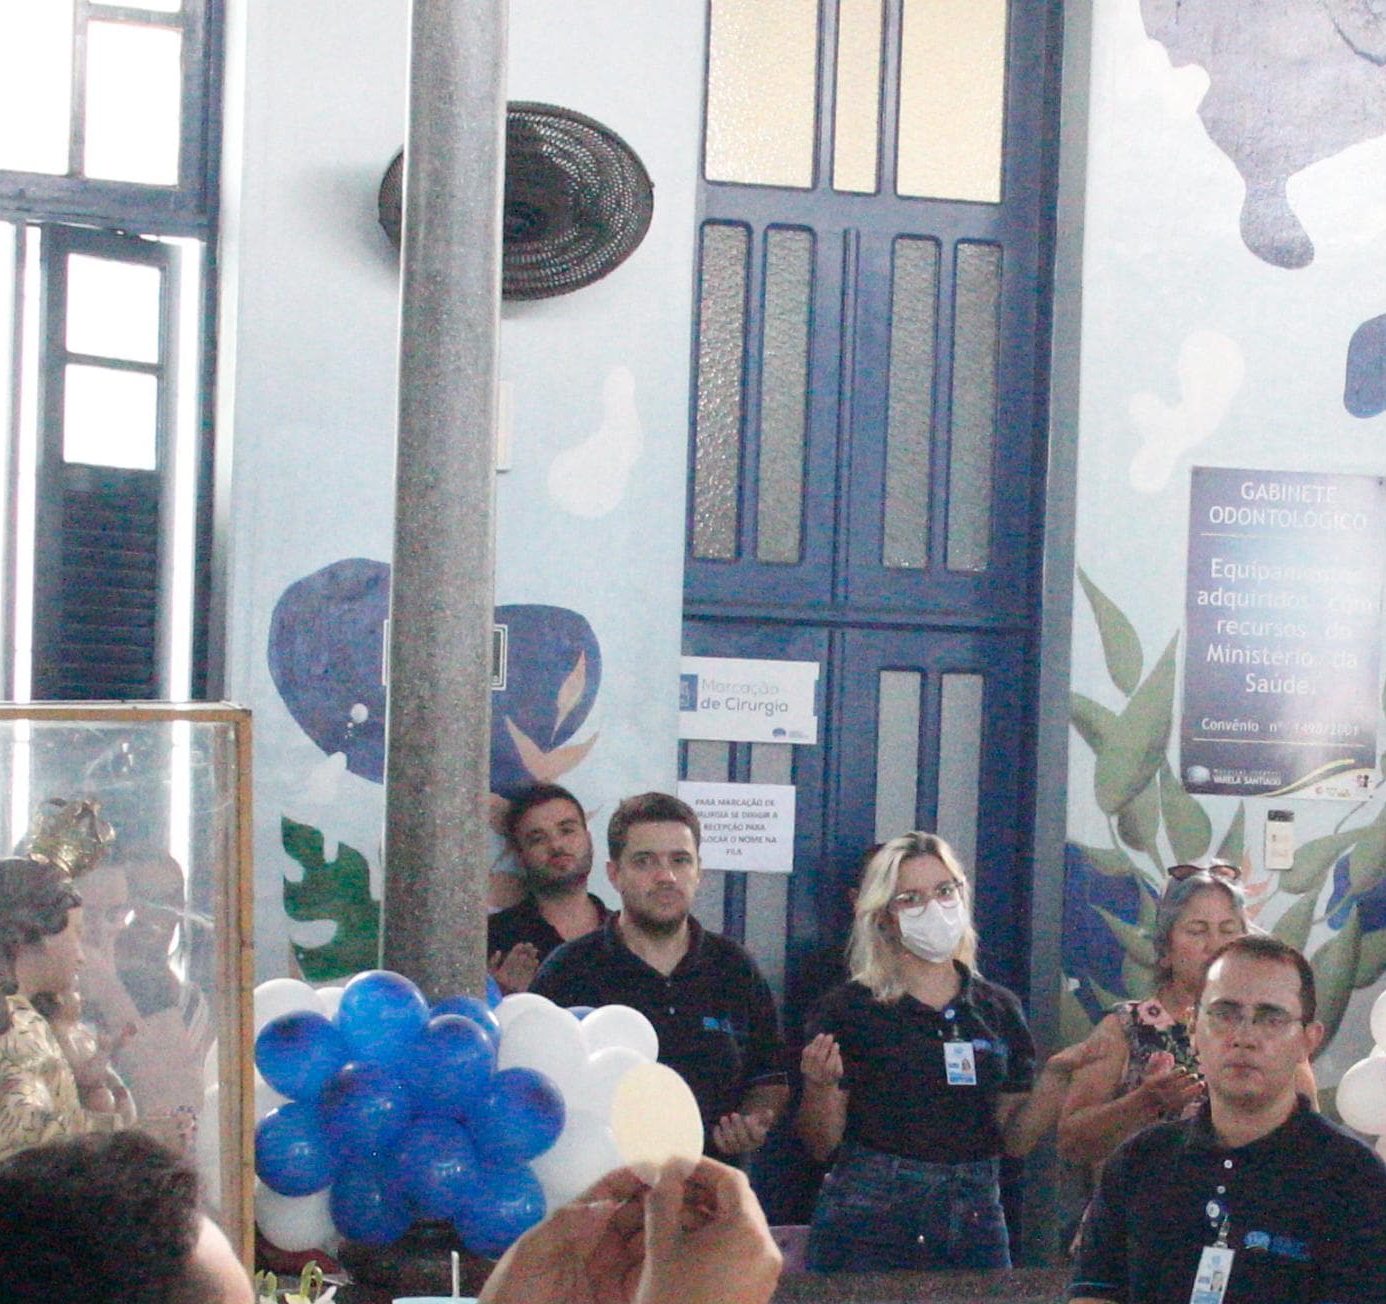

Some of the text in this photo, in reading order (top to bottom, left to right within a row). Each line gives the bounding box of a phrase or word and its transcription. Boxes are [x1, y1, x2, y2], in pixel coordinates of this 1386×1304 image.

[1241, 481, 1338, 503] GABINETE
[1217, 618, 1306, 638] recursos
[1333, 650, 1358, 668] da
[701, 678, 780, 697] Marcação
[700, 696, 789, 717] de Cirurgia
